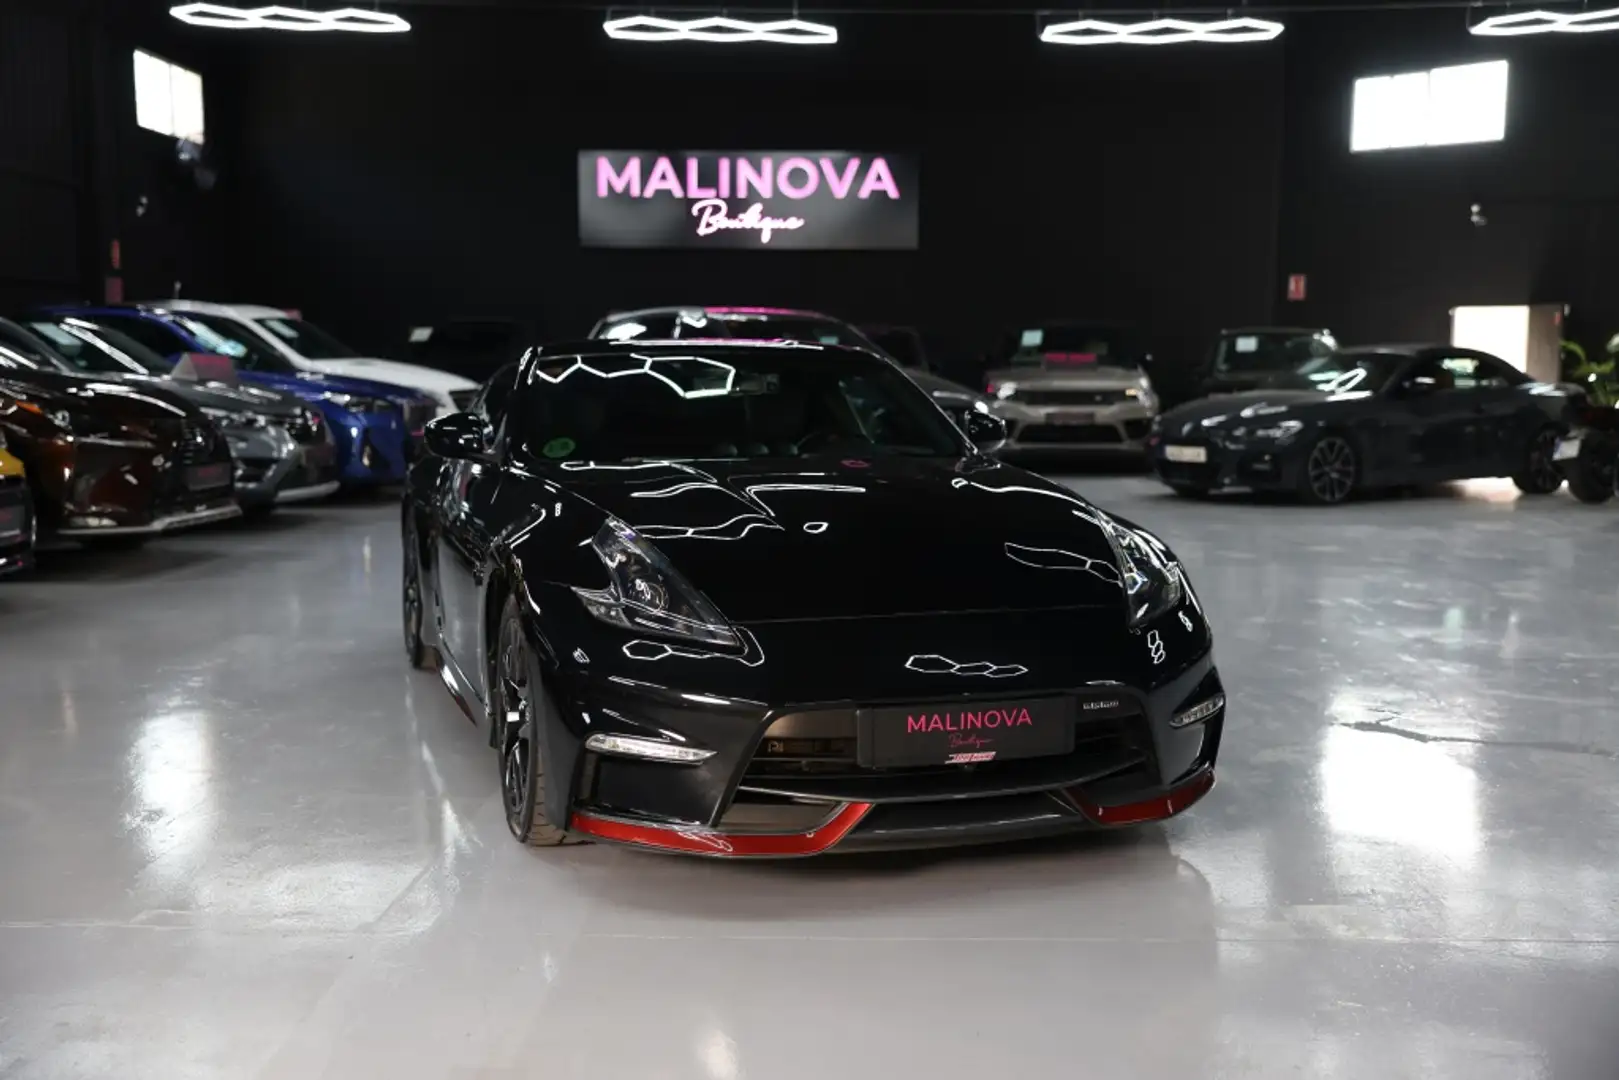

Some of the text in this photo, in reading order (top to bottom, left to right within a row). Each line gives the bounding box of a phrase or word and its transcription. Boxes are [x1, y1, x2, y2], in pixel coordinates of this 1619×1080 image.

[596, 156, 900, 199] MALINOVA
[691, 199, 805, 244] Boutique
[906, 708, 1033, 733] MALINOVA
